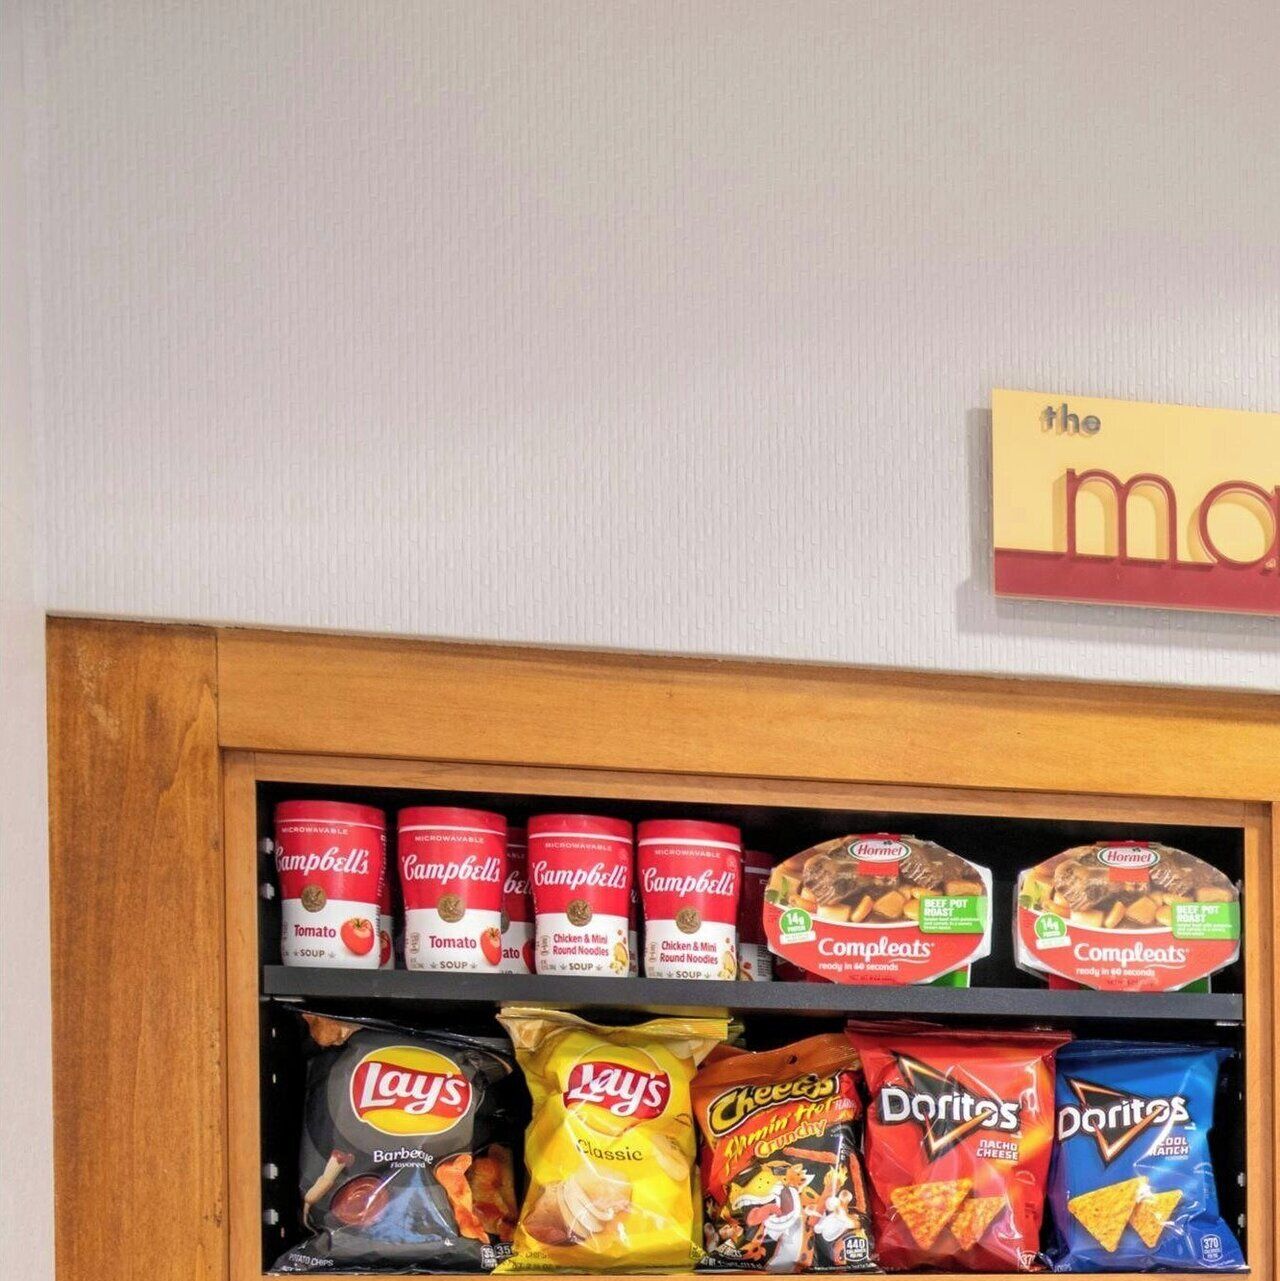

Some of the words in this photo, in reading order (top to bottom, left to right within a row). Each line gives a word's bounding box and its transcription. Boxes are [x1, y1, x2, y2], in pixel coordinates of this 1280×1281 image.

[1043, 403, 1101, 435] the
[282, 826, 349, 836] MICROWAVABLE
[415, 835, 484, 845] MICROWAVABLE
[544, 842, 612, 852] MICROWAVABLE
[856, 842, 904, 858] Hormel
[1106, 850, 1153, 865] Hormel
[401, 853, 499, 883] Campbell's
[532, 860, 628, 889] Campbell's
[924, 908, 954, 917] ROAST
[1176, 914, 1207, 923] ROAST
[294, 924, 337, 939] Tomato
[429, 935, 477, 950] Tomato
[553, 933, 583, 944] Chicken
[592, 934, 608, 945] Mini
[553, 945, 575, 956] Round
[577, 945, 609, 957] Noodles
[661, 940, 690, 951] Chicken
[699, 941, 716, 952] Mini
[818, 936, 931, 960] Compleats
[300, 949, 325, 958] SOUP
[659, 953, 683, 964] Round
[685, 954, 718, 965] Noodles
[1073, 943, 1186, 965] Compleats
[440, 960, 468, 969] SOUP
[818, 963, 841, 972] ready
[866, 963, 898, 971] seconds
[1075, 967, 1098, 976] ready
[1101, 967, 1109, 975] in
[1123, 967, 1156, 976] seconds
[360, 1062, 467, 1116] Lay's
[568, 1062, 666, 1118] Lay's
[879, 1087, 1020, 1129] Doritos
[1058, 1096, 1188, 1139] Doritos
[755, 1119, 827, 1158] Crunchy
[577, 1138, 643, 1162] Classic
[980, 1139, 1018, 1152] NACHO
[976, 1149, 1019, 1161] CHEESE
[846, 1241, 865, 1249] 440
